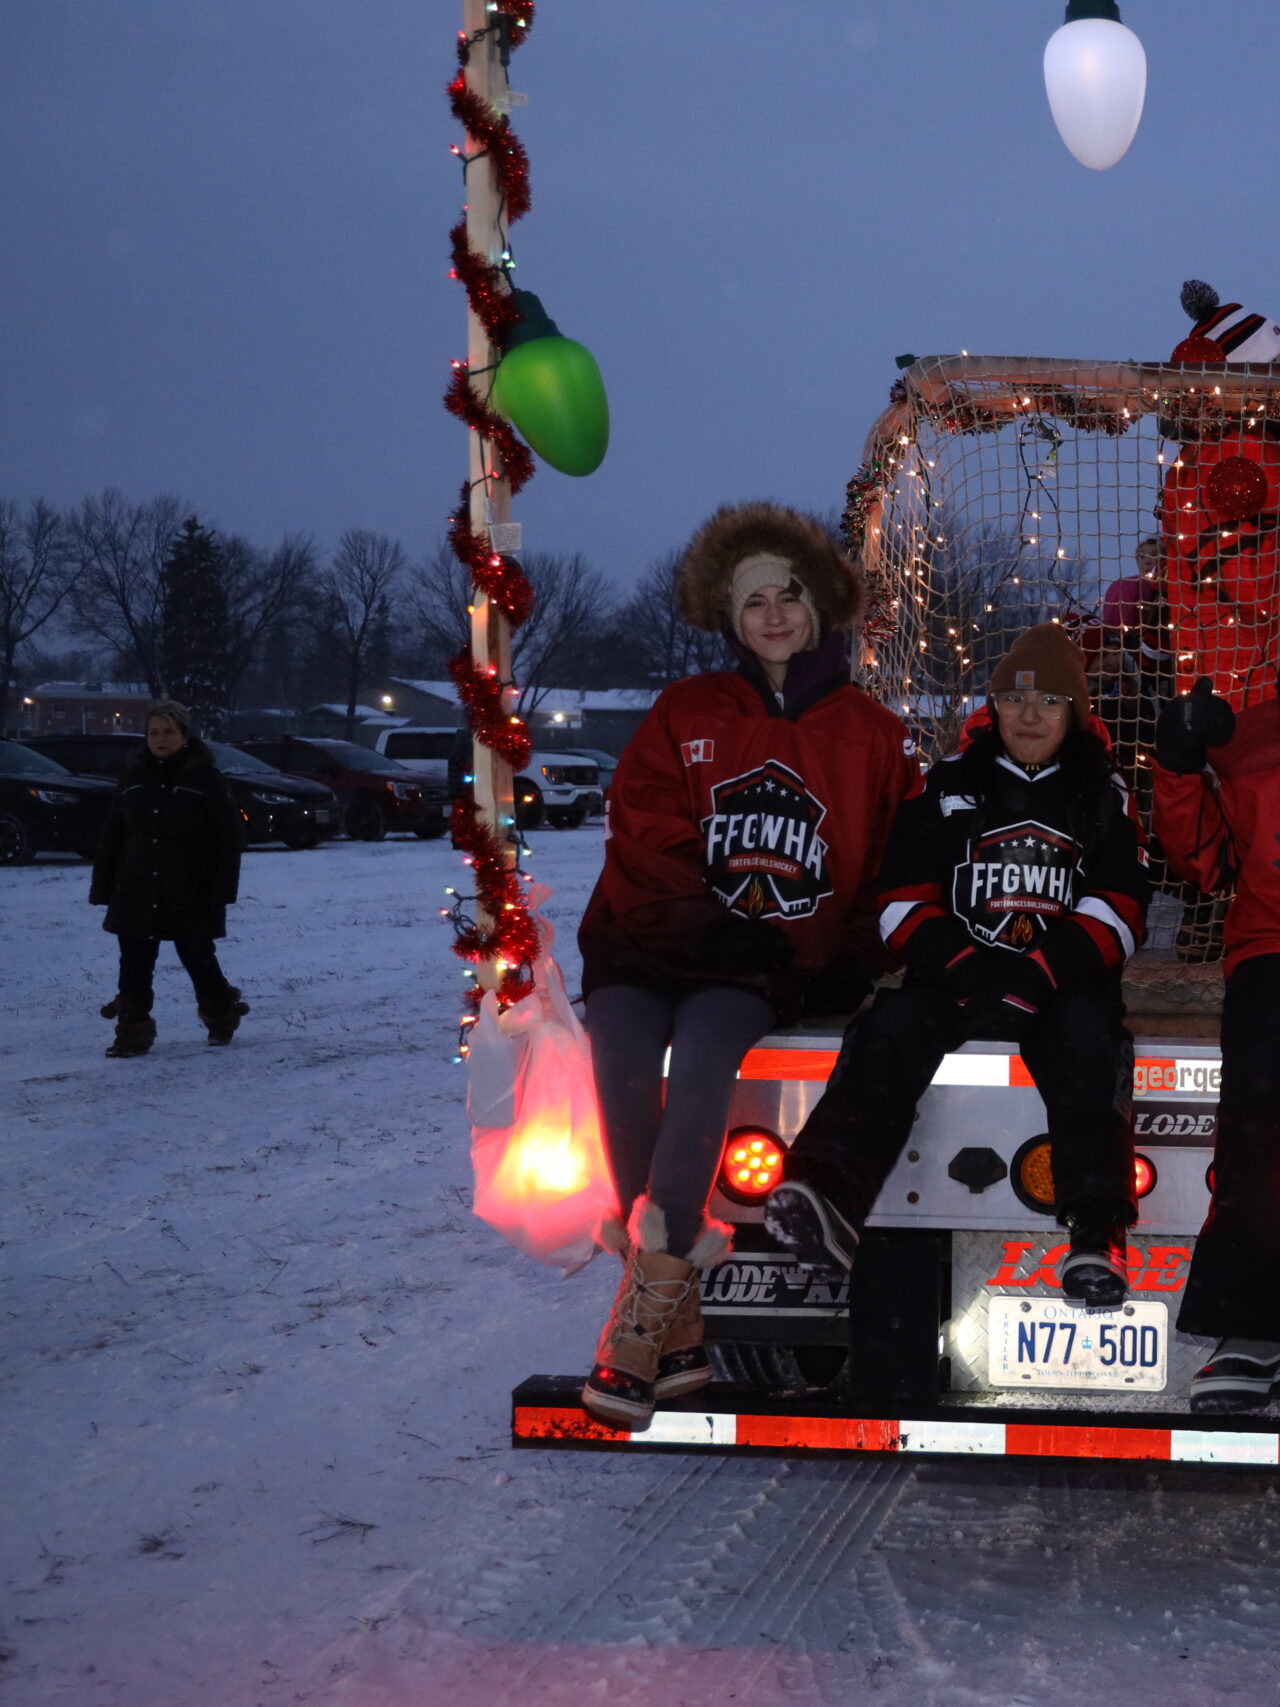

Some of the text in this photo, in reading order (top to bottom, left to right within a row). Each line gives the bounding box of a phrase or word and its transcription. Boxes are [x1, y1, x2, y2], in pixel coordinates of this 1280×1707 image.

[1134, 1113, 1216, 1136] LODE
[700, 1263, 782, 1303] LODE
[1017, 1321, 1158, 1368] N77 50D
